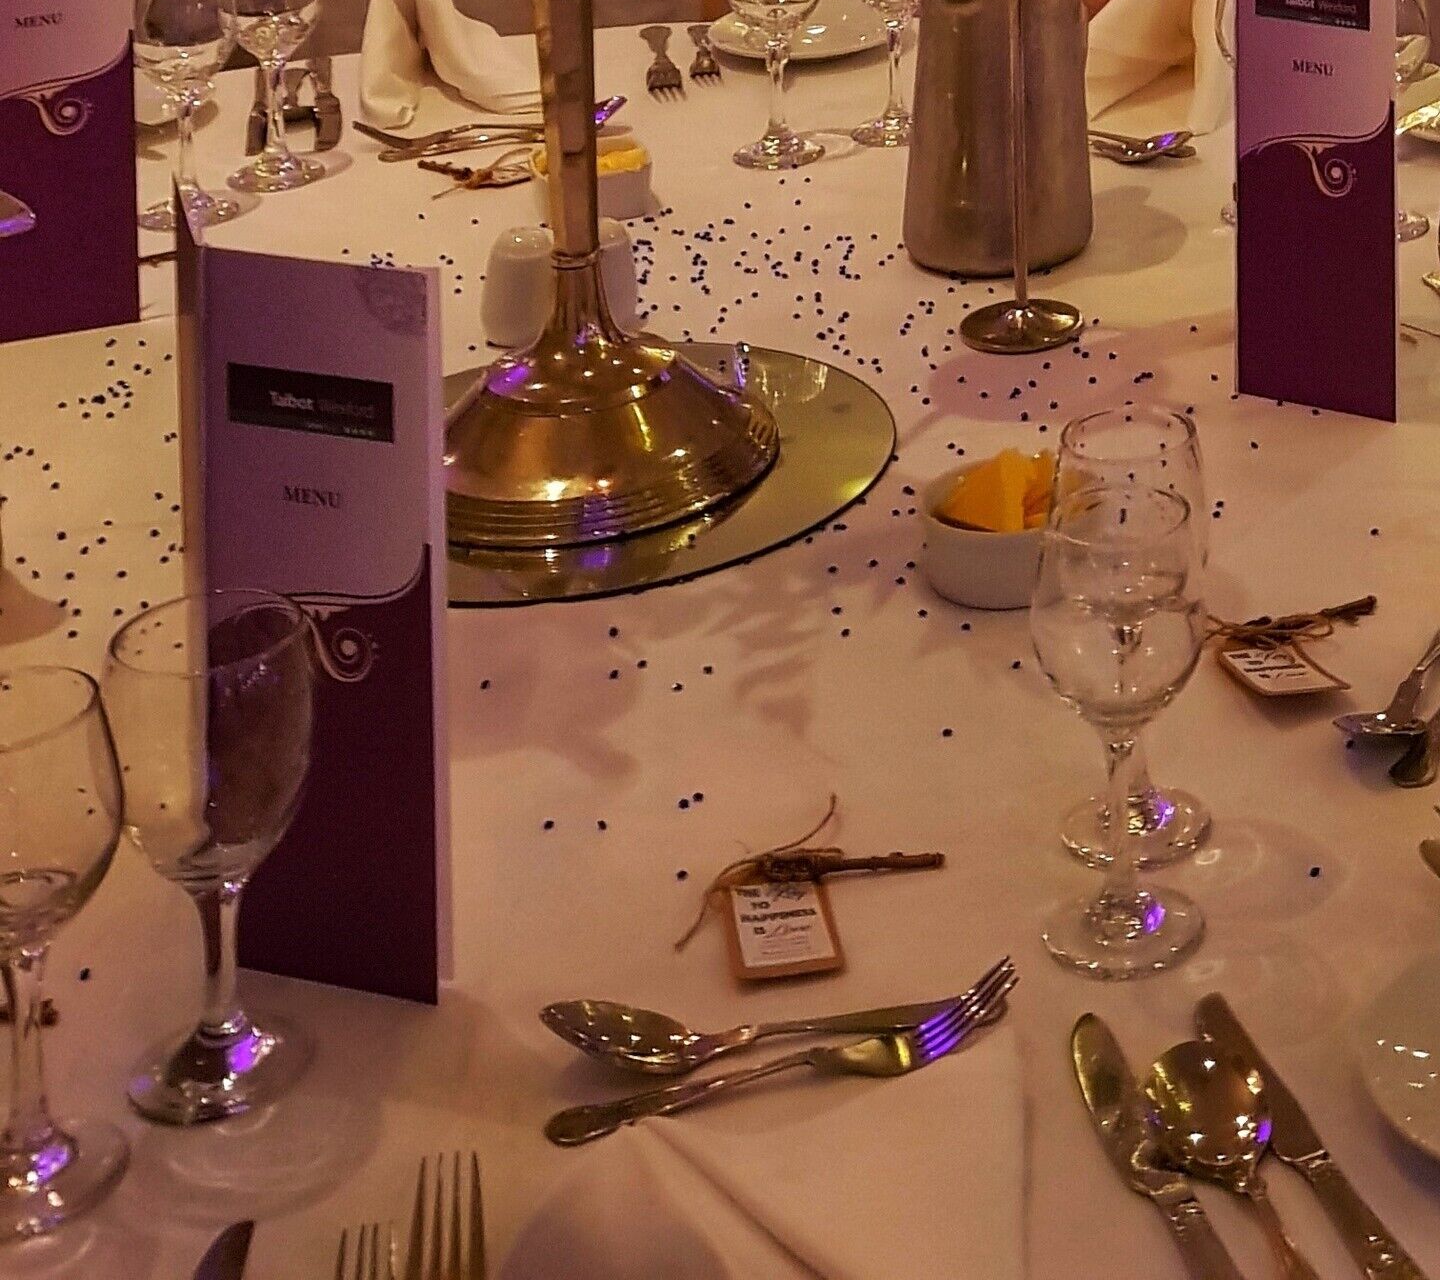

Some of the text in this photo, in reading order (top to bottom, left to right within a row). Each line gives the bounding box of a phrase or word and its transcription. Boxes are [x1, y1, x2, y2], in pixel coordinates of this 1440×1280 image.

[14, 13, 63, 28] MENU
[1292, 59, 1334, 77] MENU
[283, 485, 343, 509] MENU
